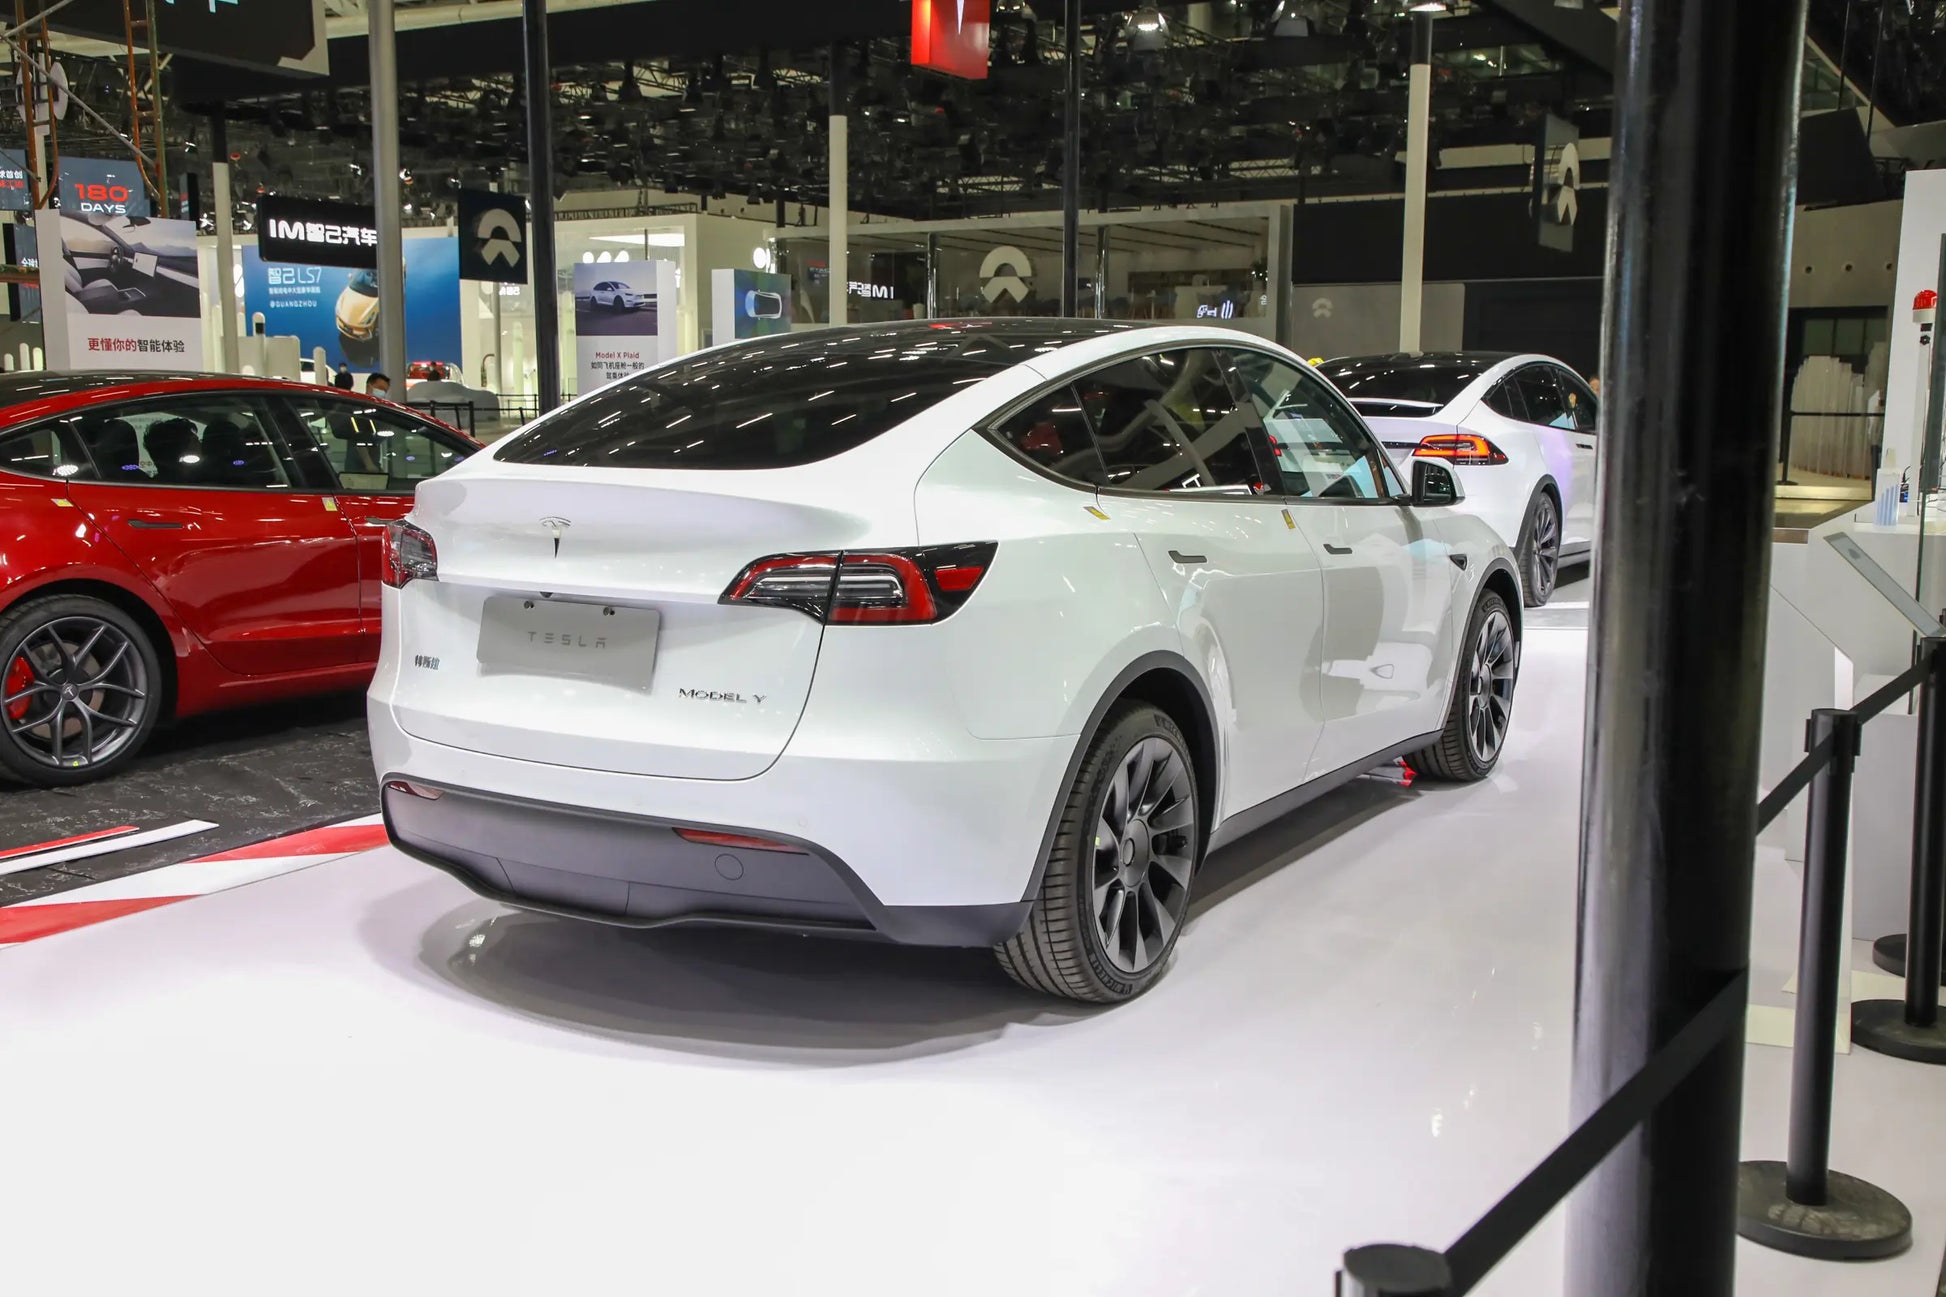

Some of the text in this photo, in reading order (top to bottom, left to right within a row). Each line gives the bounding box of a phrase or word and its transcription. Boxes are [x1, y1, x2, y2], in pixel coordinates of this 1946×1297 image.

[75, 183, 128, 202] 180
[81, 202, 126, 214] DAYS
[87, 337, 185, 353] 更懂你的智能体验
[595, 351, 615, 359] Model
[623, 351, 640, 359] Plaid
[528, 631, 608, 648] TESLA
[678, 688, 767, 705] MODEL Y
